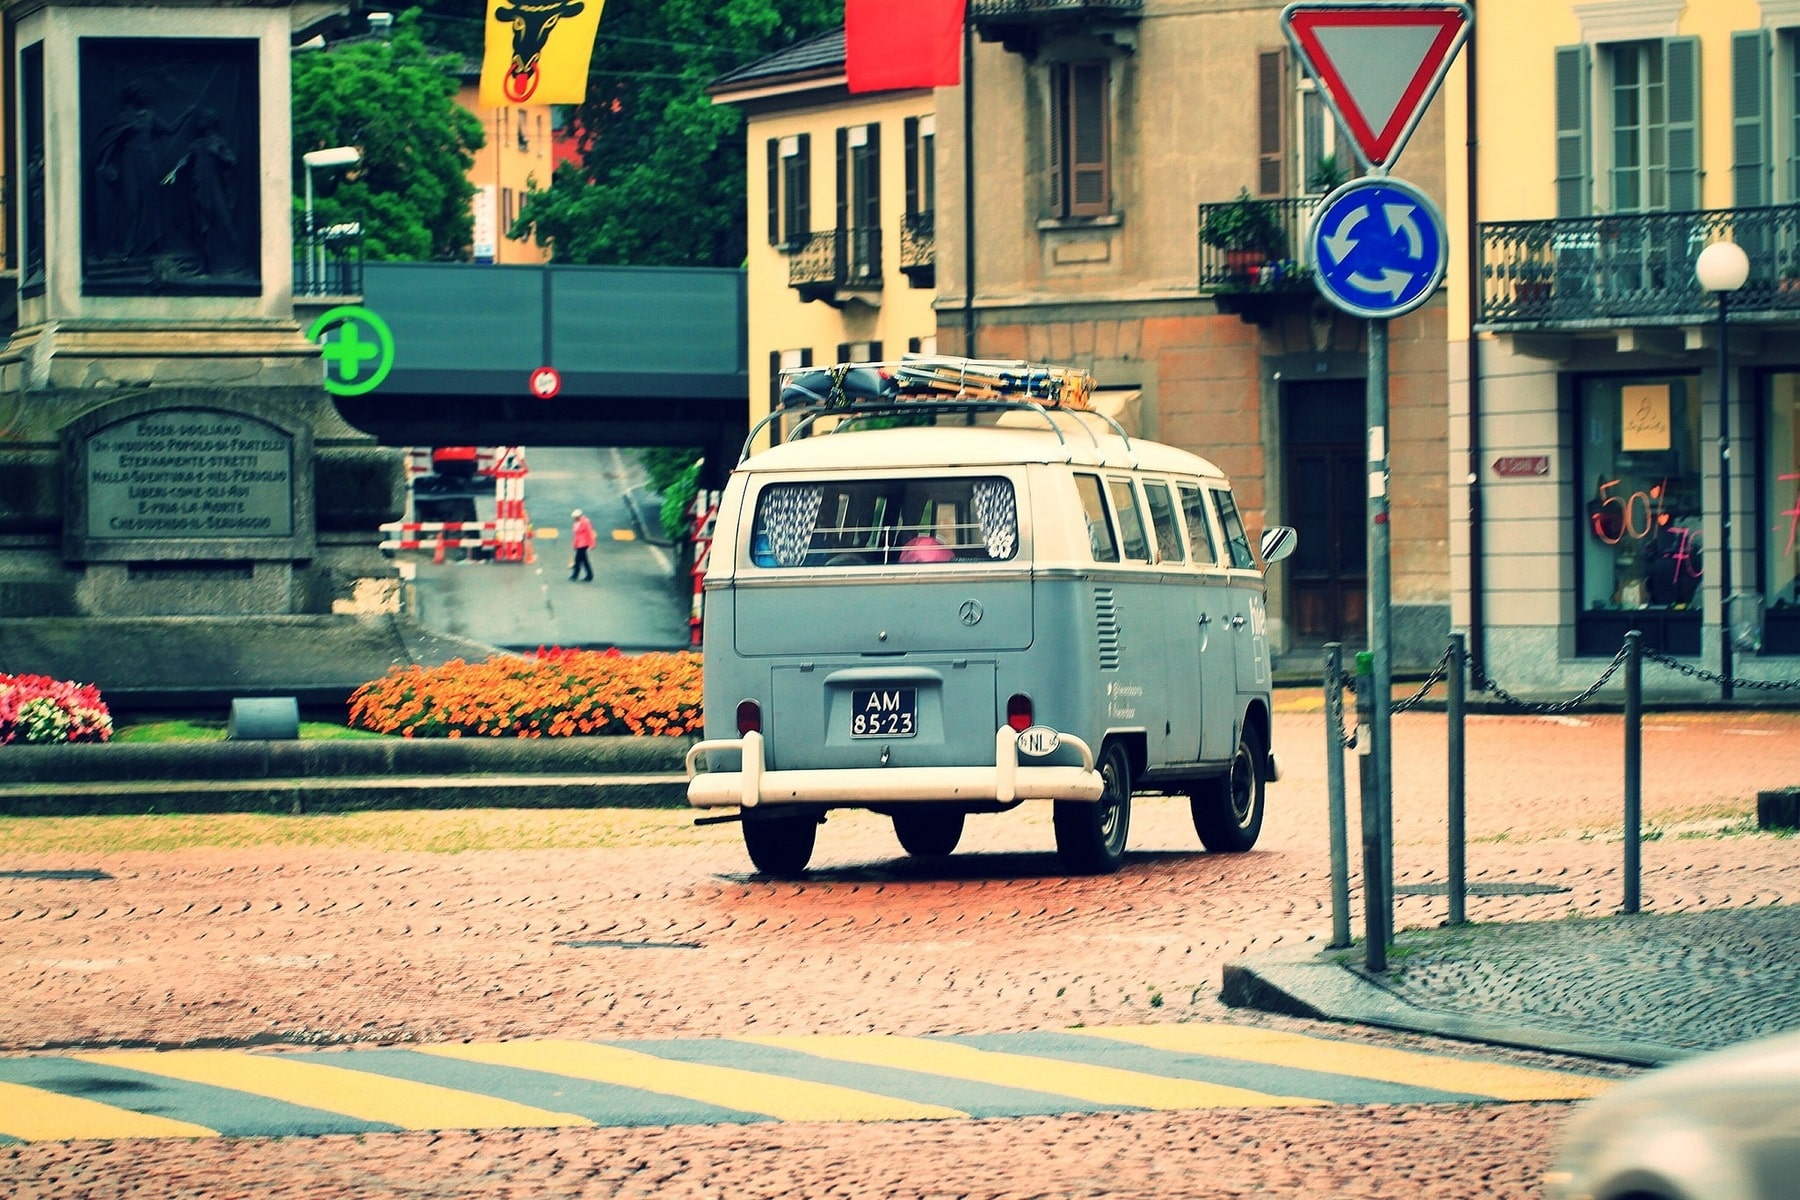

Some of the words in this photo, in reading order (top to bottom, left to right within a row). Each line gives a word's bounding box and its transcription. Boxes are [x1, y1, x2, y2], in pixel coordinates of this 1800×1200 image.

[1591, 476, 1668, 545] 50%
[865, 690, 900, 713] AM
[853, 713, 913, 735] 85-23
[1029, 733, 1050, 753] NL
